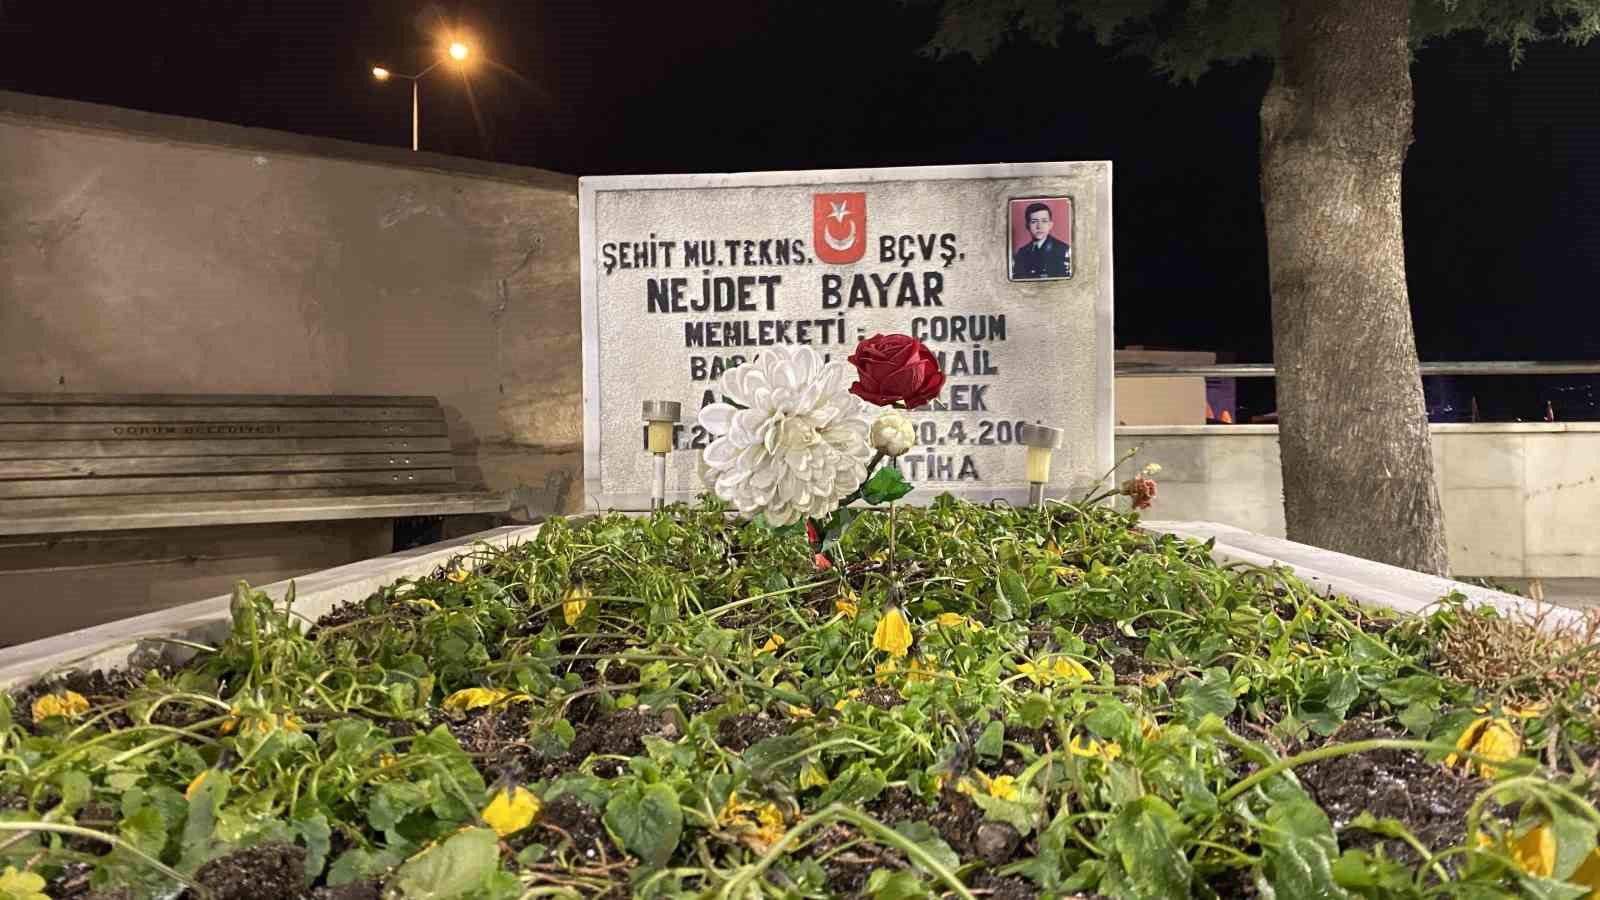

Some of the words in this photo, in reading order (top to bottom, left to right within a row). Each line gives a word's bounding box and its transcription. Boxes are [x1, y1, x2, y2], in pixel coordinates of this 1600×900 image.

[602, 233, 675, 274] ŞEHİT
[879, 232, 965, 268] BÇVŞ.
[647, 269, 781, 313] NEJDET
[822, 271, 944, 309] BAYAR
[684, 311, 846, 348] MEMLEKETİ
